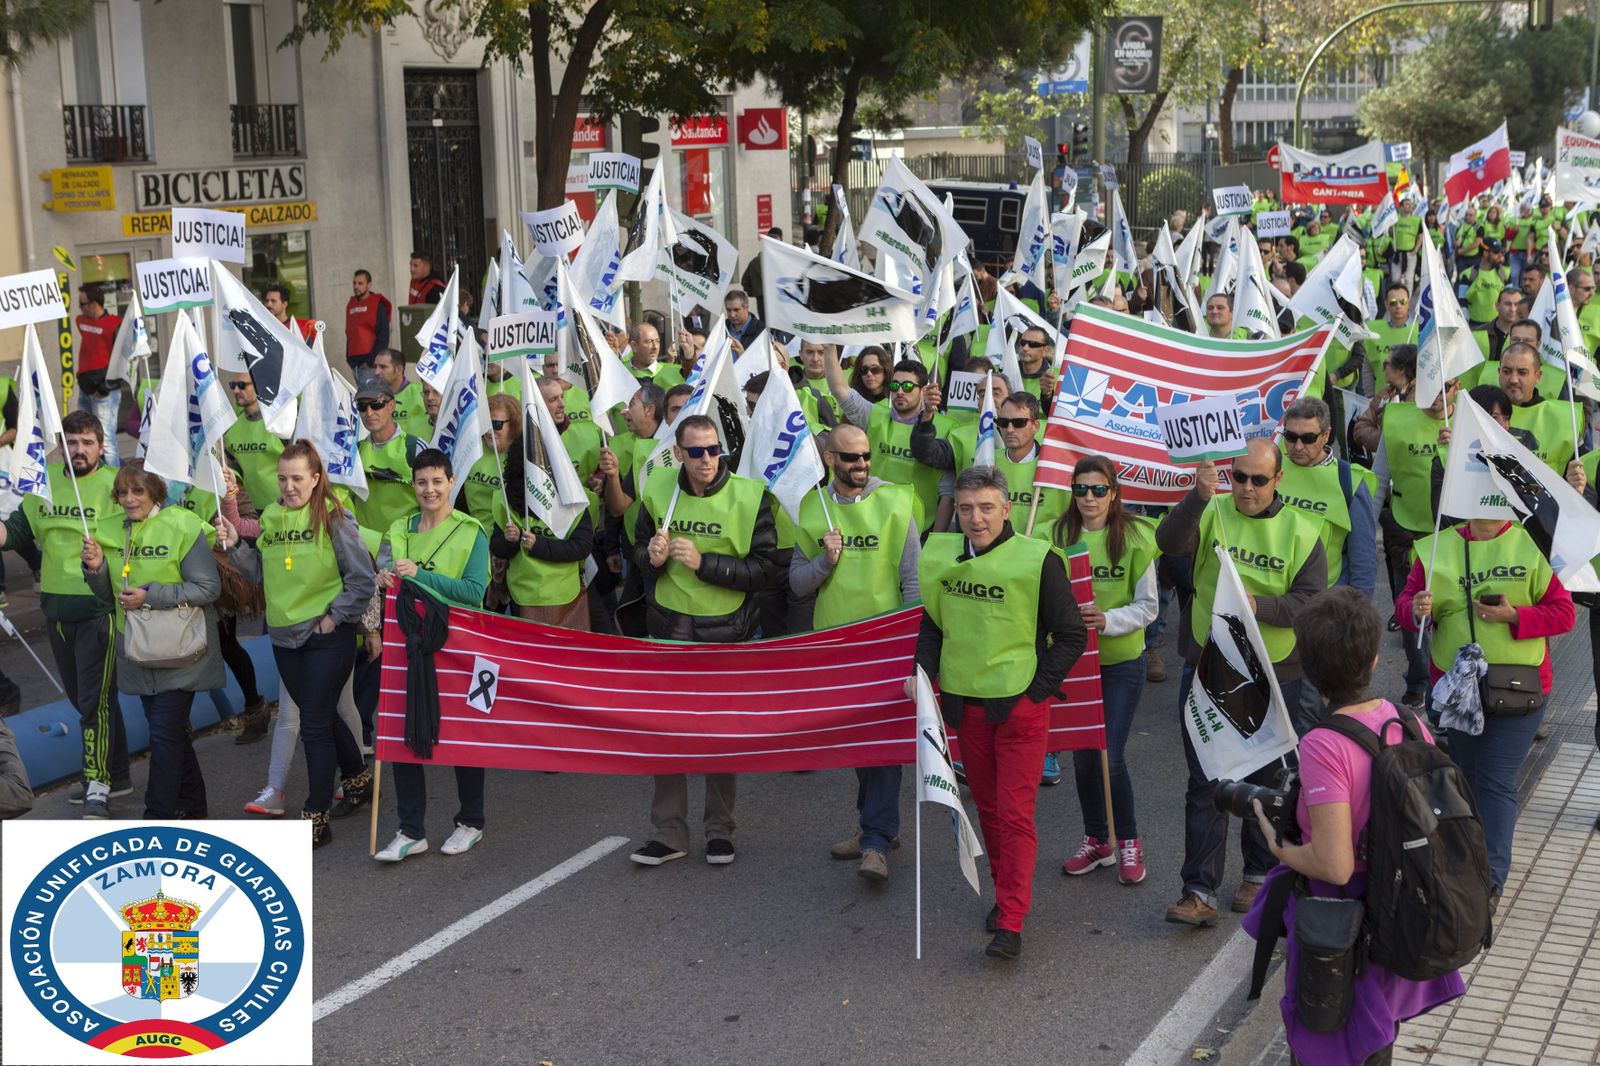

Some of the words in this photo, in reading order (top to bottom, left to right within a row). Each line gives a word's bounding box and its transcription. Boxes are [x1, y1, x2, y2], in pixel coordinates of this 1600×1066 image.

[573, 125, 600, 142] ander
[590, 161, 639, 185] JUSTICIA!
[142, 167, 303, 207] BICICLETAS
[131, 215, 172, 233] REPA
[250, 205, 311, 224] CALZADO
[532, 211, 582, 245] USTICIA!
[174, 221, 244, 248] JUSTICIA!
[142, 267, 209, 300] JUSTICIA!
[0, 282, 61, 312] USTICIA!
[490, 321, 554, 350] JUSTICIA!
[950, 381, 978, 401] JUST
[1164, 408, 1243, 449] JUSTICIA!
[1118, 462, 1231, 488] ZAMOA
[1008, 492, 1045, 503] UGC
[670, 520, 722, 536] AUGC
[842, 535, 879, 547] UGC
[1228, 546, 1285, 570] AUGC
[1091, 565, 1125, 578] GC
[1471, 565, 1527, 586] AUGC
[955, 580, 1005, 599] AUGC
[1204, 706, 1224, 733] 14-N
